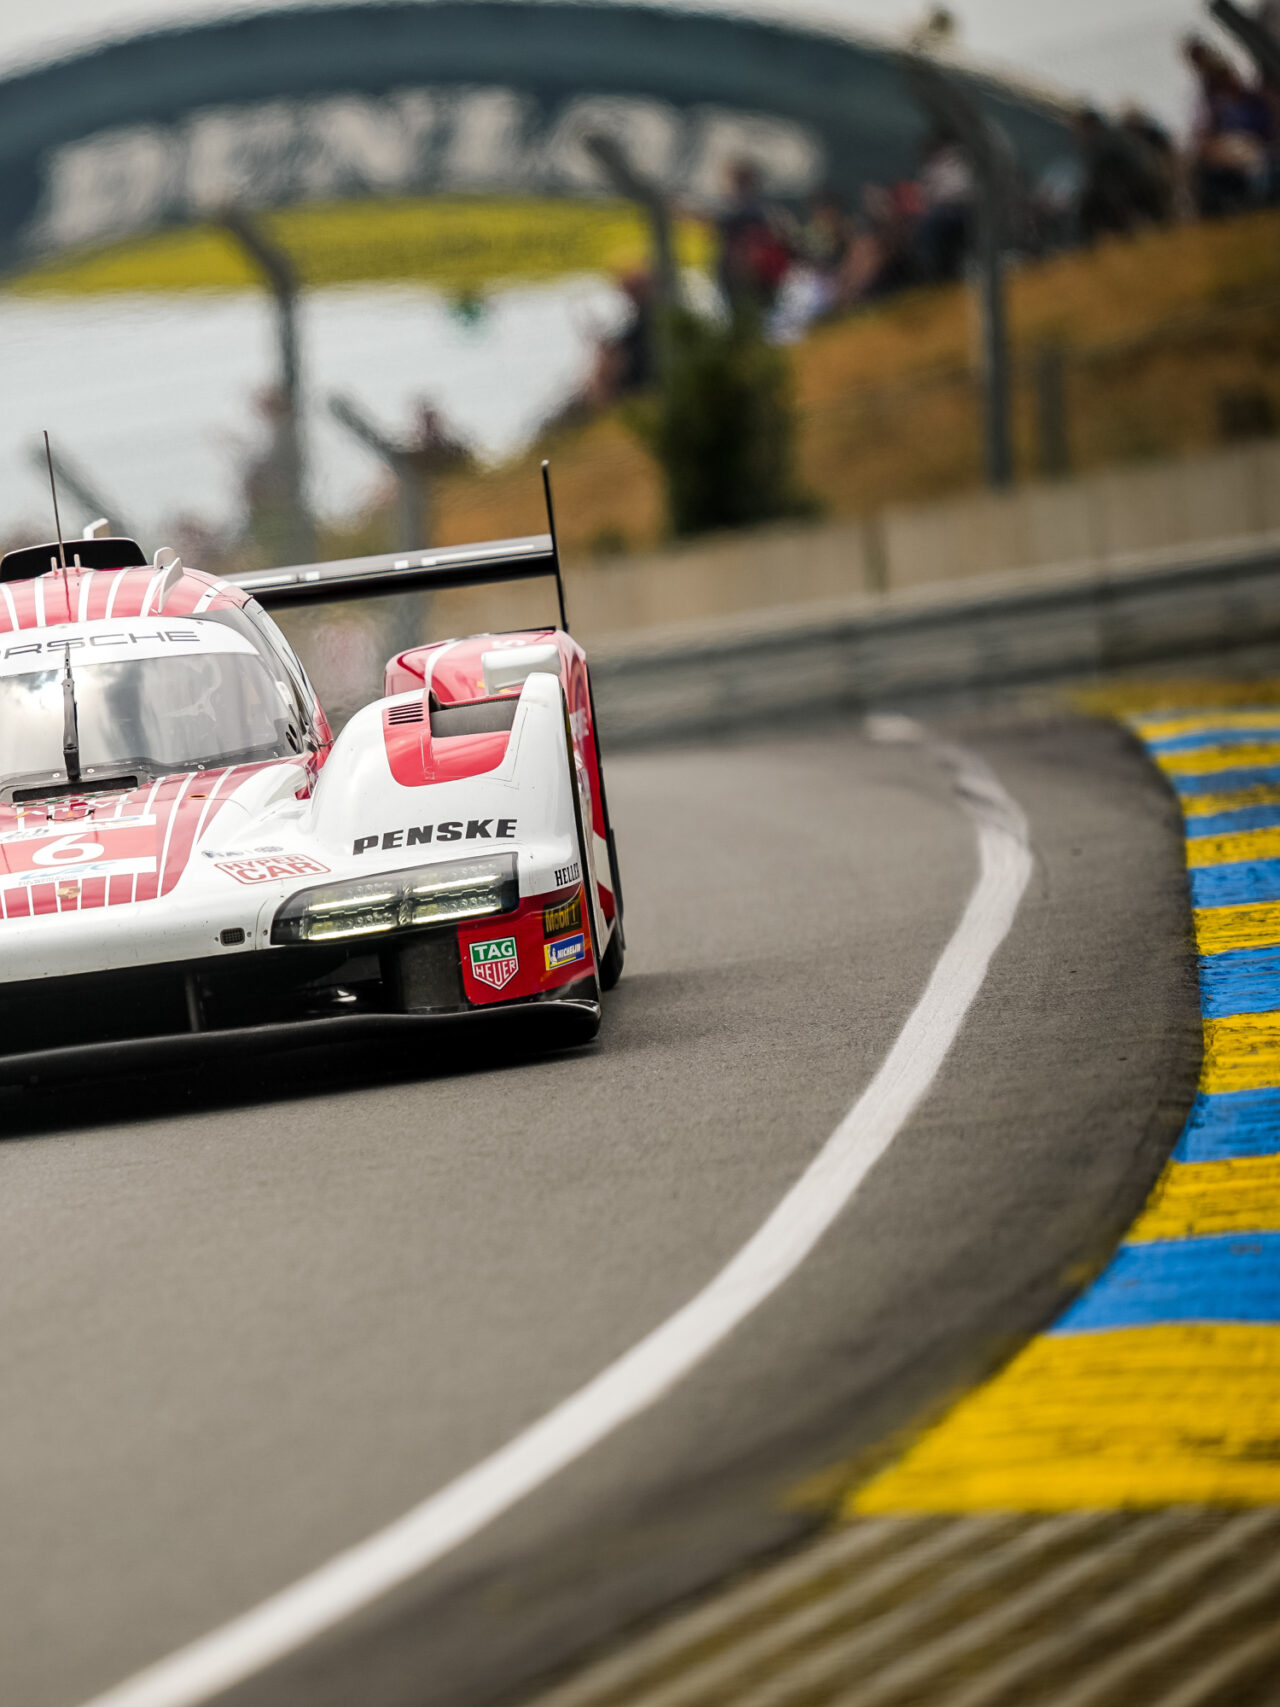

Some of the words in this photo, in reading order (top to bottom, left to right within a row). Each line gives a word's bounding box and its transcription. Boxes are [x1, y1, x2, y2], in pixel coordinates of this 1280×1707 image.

[353, 818, 518, 856] PENSKE
[32, 834, 105, 866] 6
[223, 856, 305, 870] HYPER
[236, 861, 321, 881] CAR
[554, 862, 580, 887] HELLER
[474, 941, 513, 960] TAG
[557, 943, 581, 959] MICHELIN
[475, 959, 517, 986] HEUER
